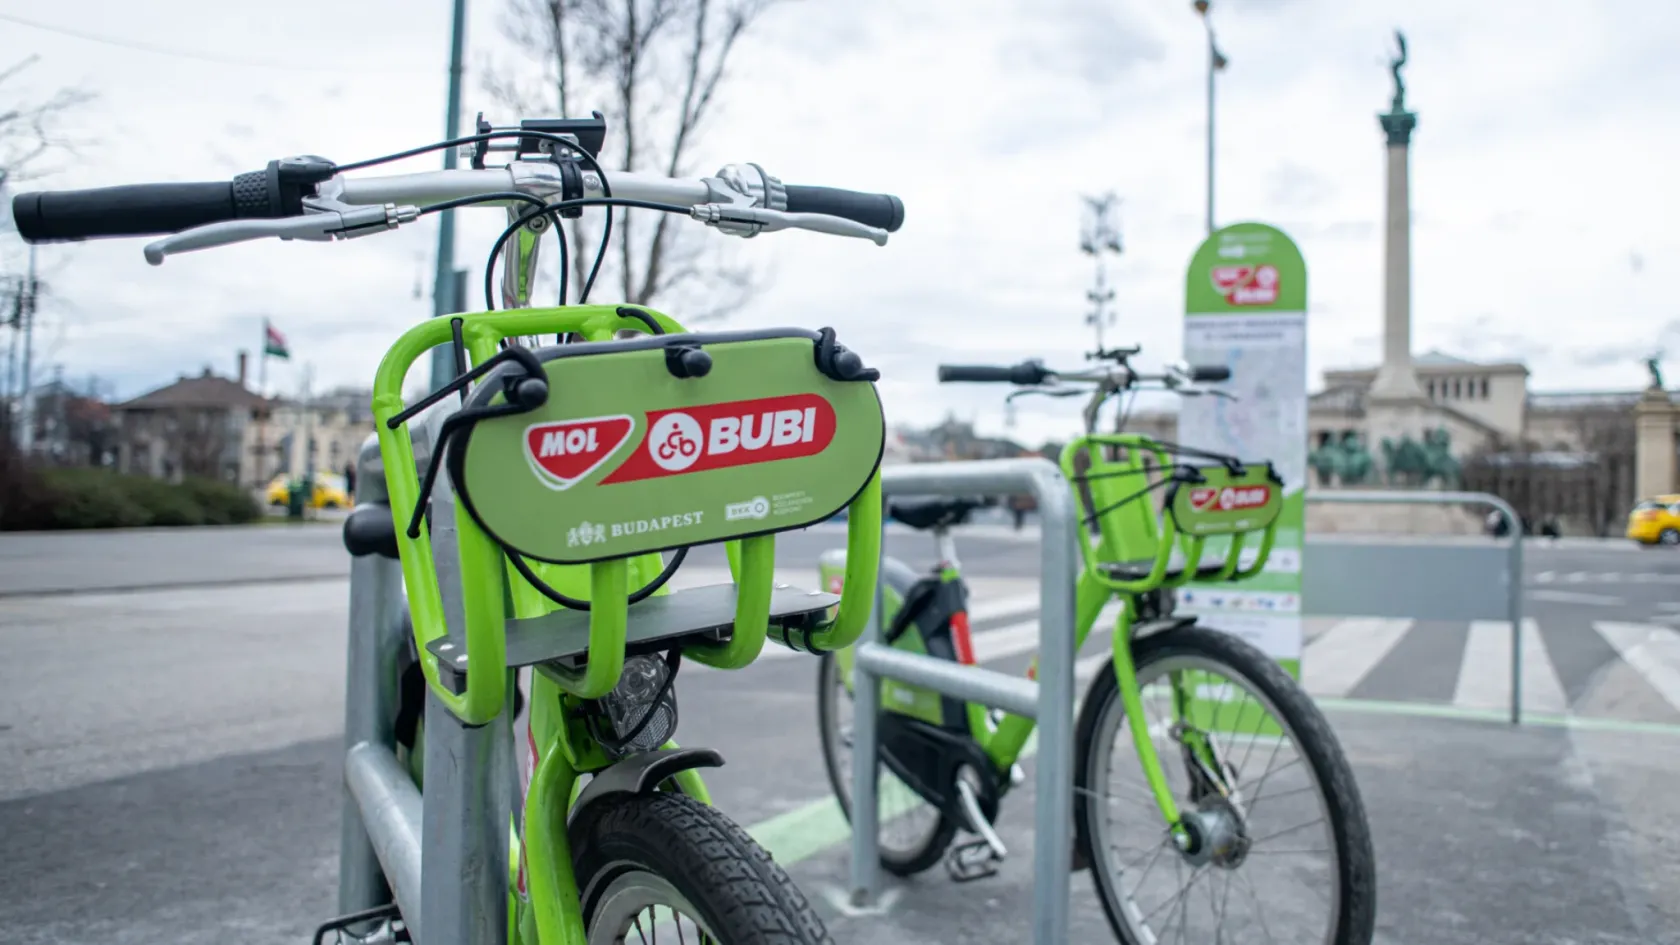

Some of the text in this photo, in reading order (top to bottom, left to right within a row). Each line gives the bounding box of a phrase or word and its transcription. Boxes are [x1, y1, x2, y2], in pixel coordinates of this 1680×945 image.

[539, 407, 816, 458] MOL BUBI
[611, 511, 704, 537] BUDAPEST
